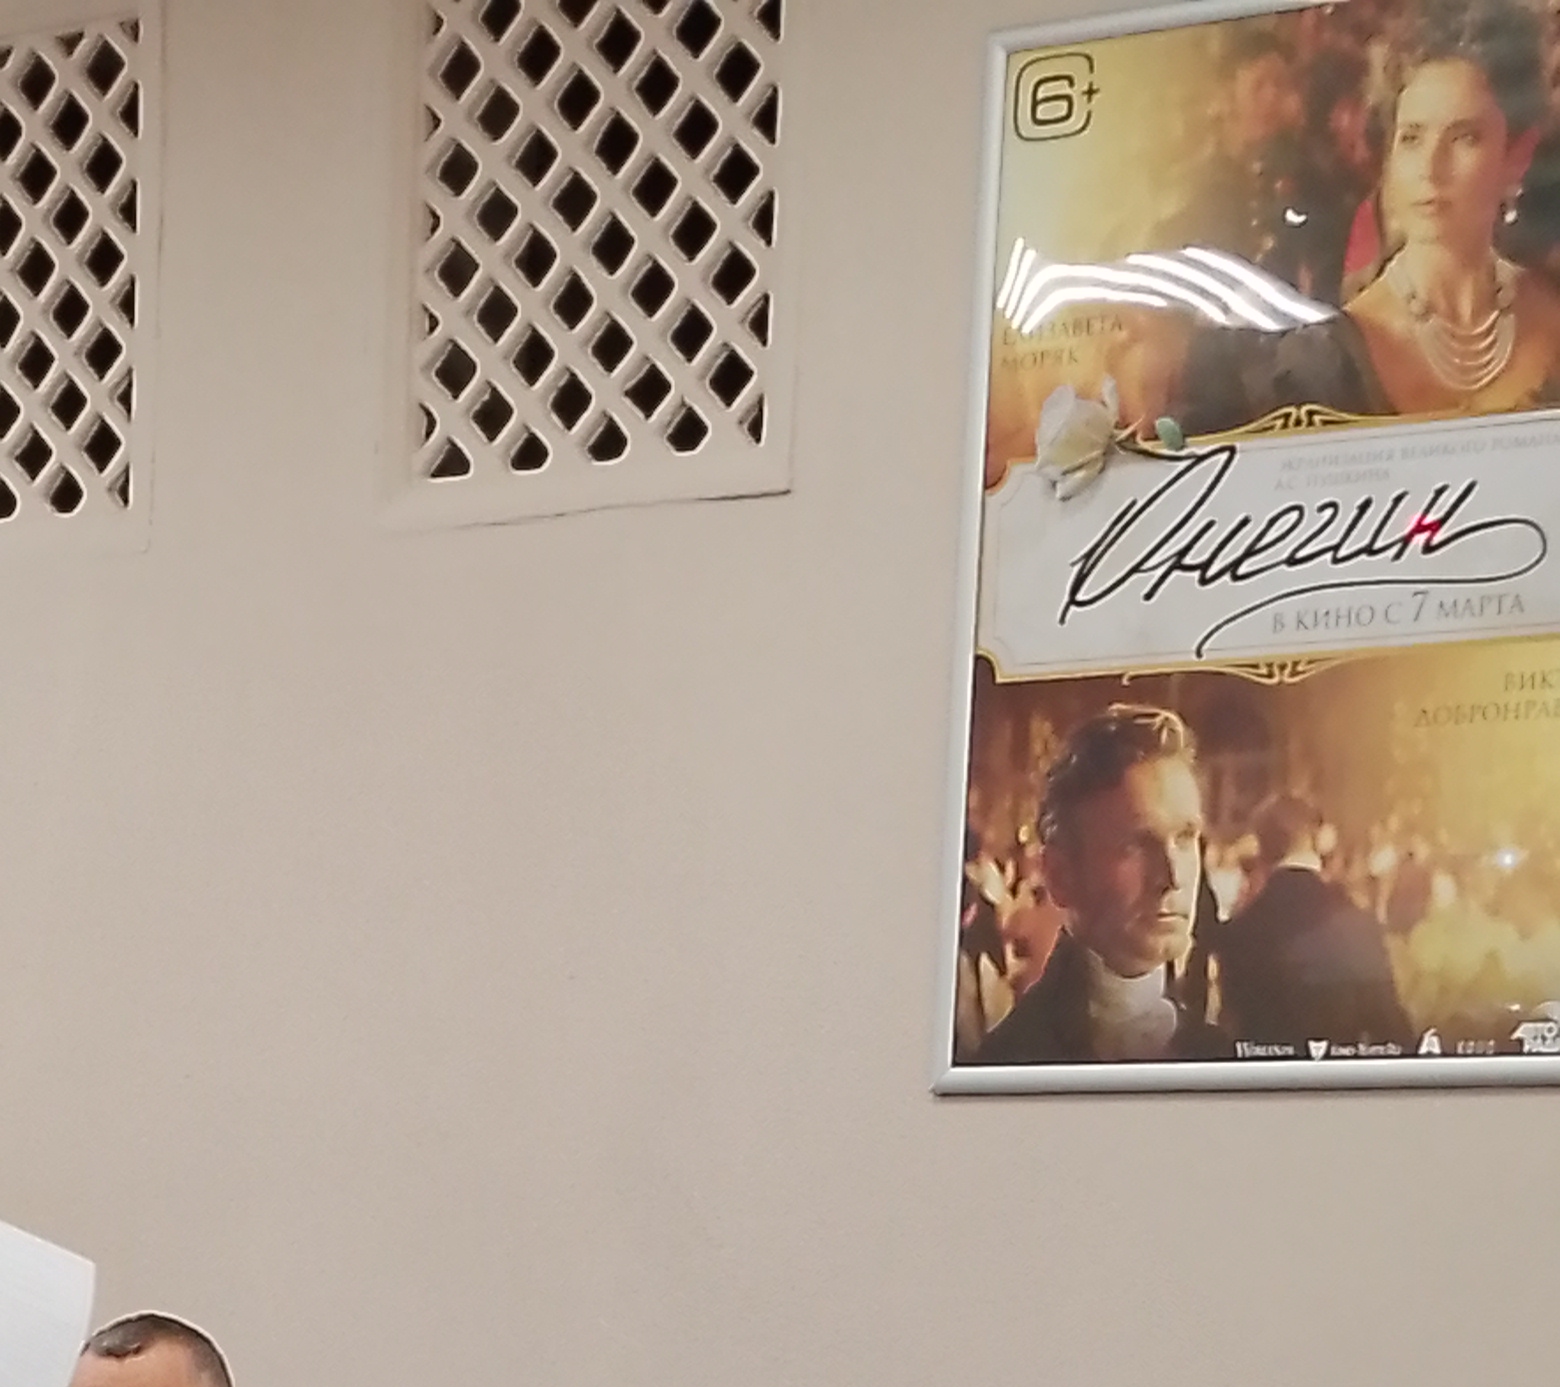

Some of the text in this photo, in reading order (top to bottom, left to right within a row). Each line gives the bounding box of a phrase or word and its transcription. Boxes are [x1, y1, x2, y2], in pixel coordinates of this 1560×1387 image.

[1031, 74, 1100, 126] 6+
[1295, 603, 1375, 631] КИНО
[1411, 590, 1429, 623] 7
[1437, 593, 1525, 620] МАРТА
